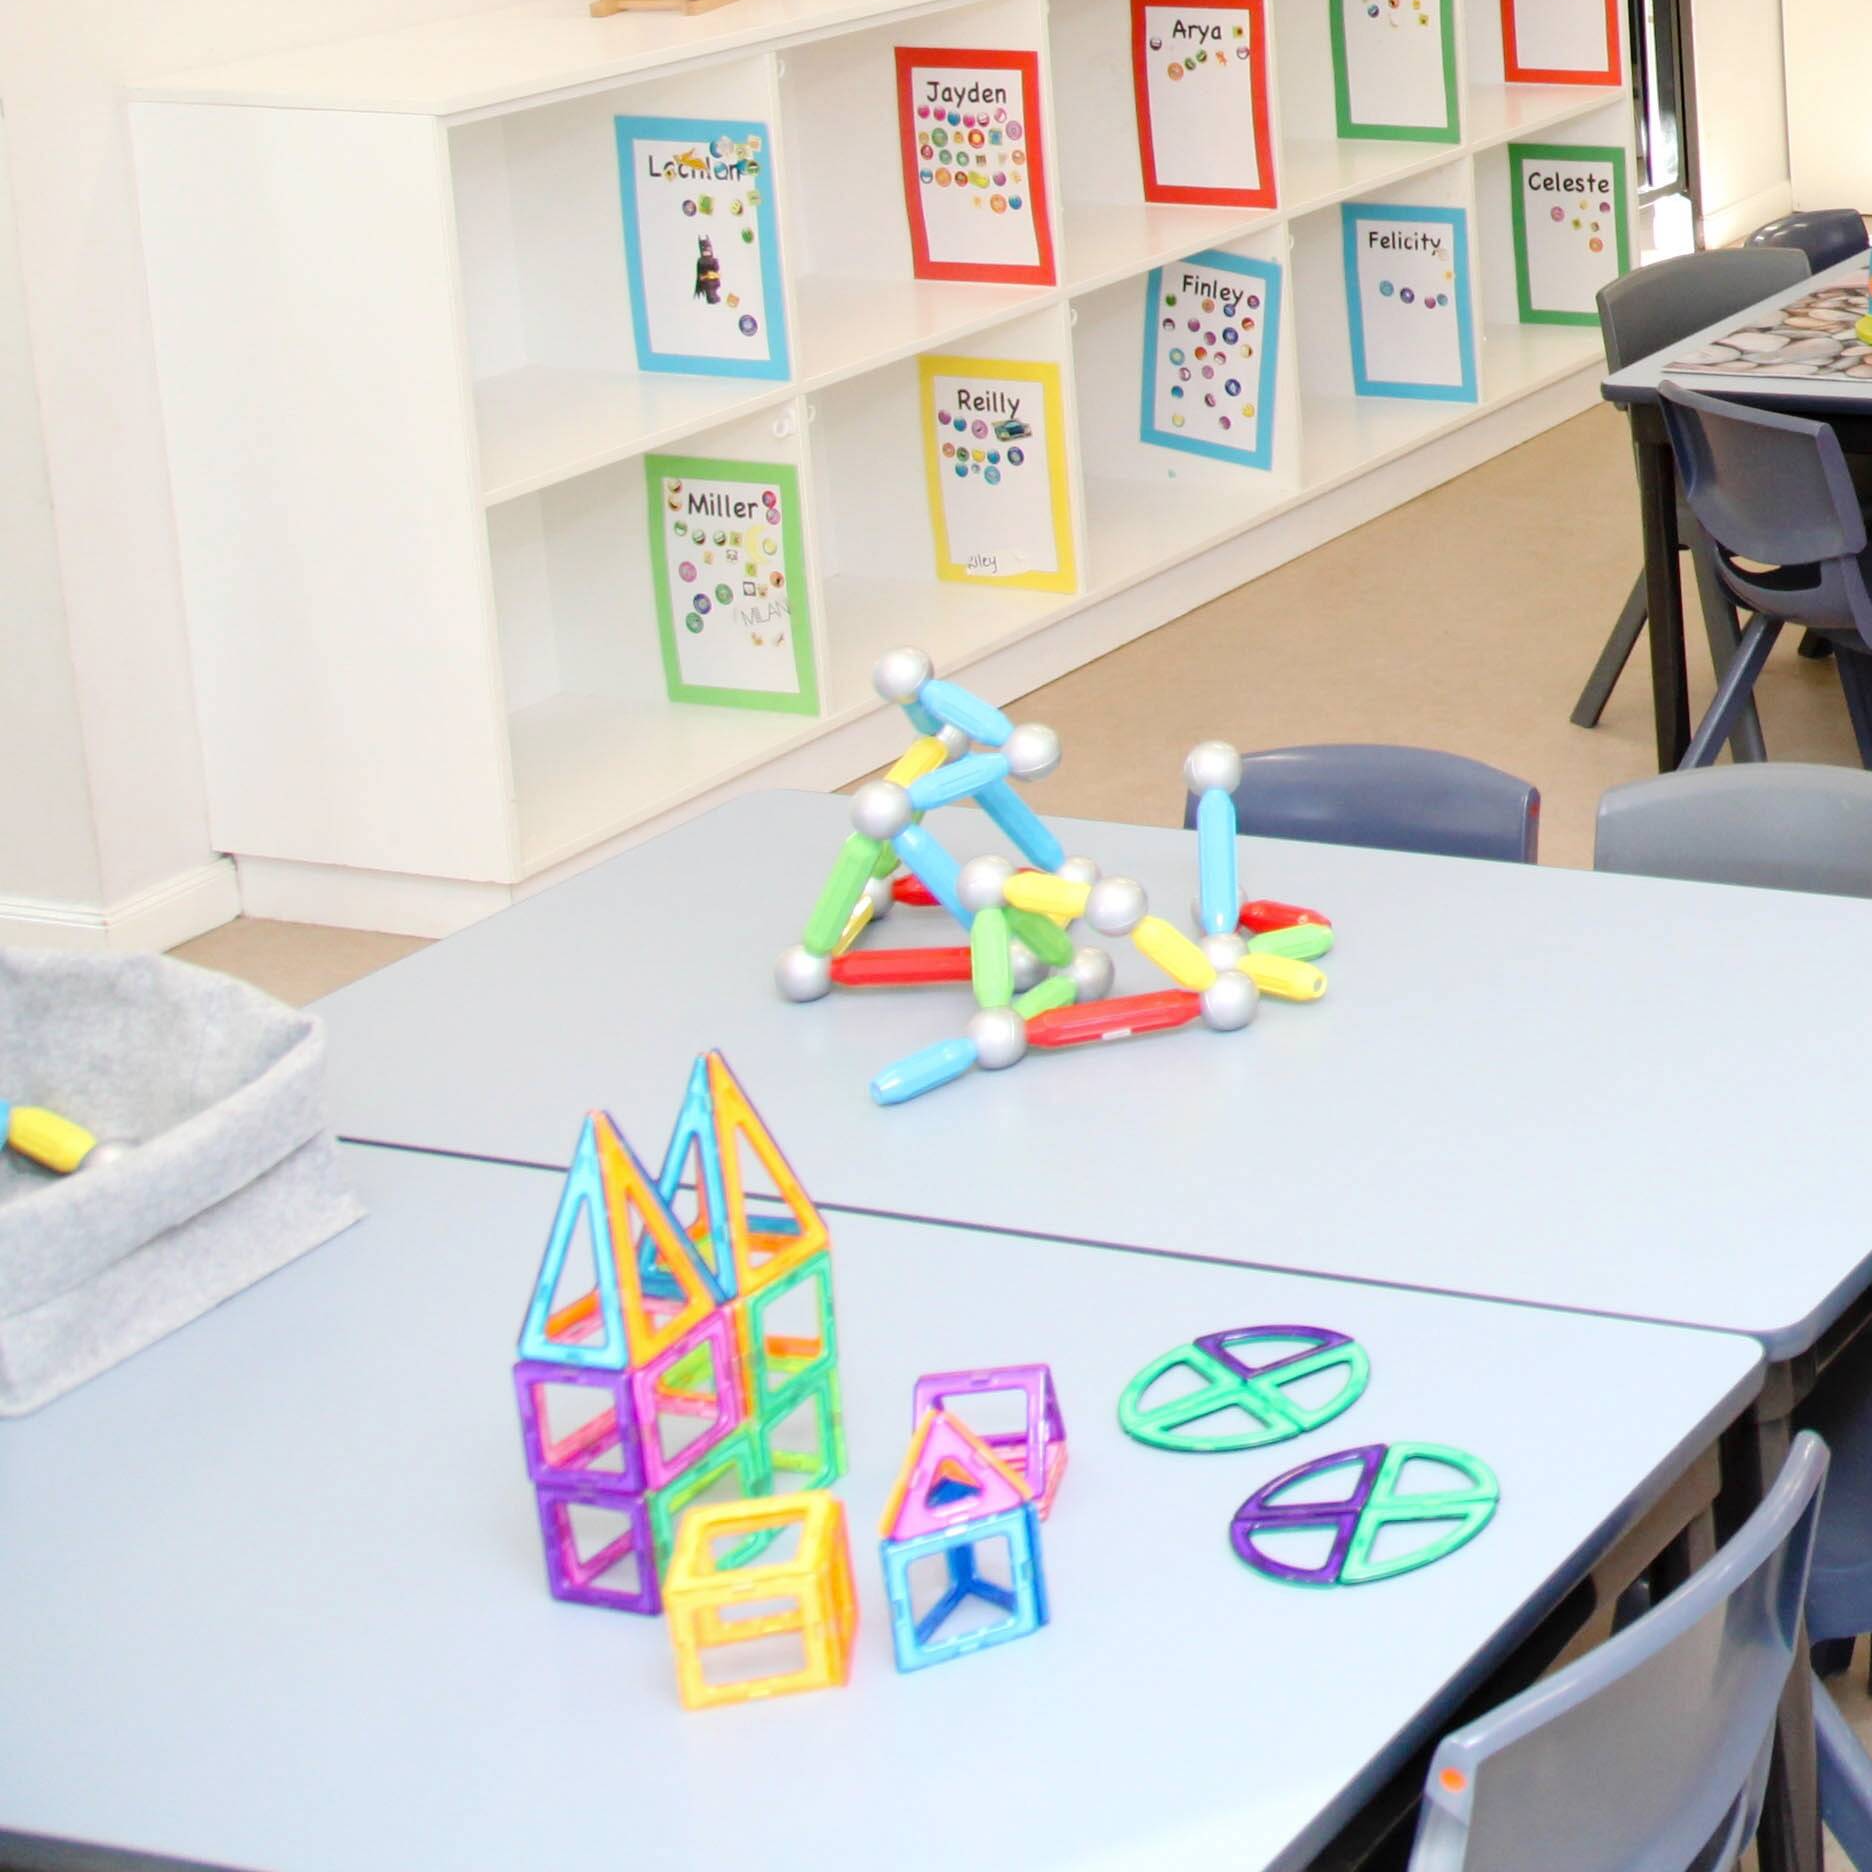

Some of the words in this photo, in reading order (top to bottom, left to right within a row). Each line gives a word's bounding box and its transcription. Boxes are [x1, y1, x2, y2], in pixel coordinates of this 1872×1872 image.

[1171, 19, 1223, 43] Arya
[926, 81, 1007, 108] Jayden
[1528, 171, 1612, 195] Celeste
[1368, 231, 1442, 257] Felicity
[1182, 274, 1245, 308] Finley
[957, 389, 1021, 419] Reilly
[688, 492, 759, 519] Miller
